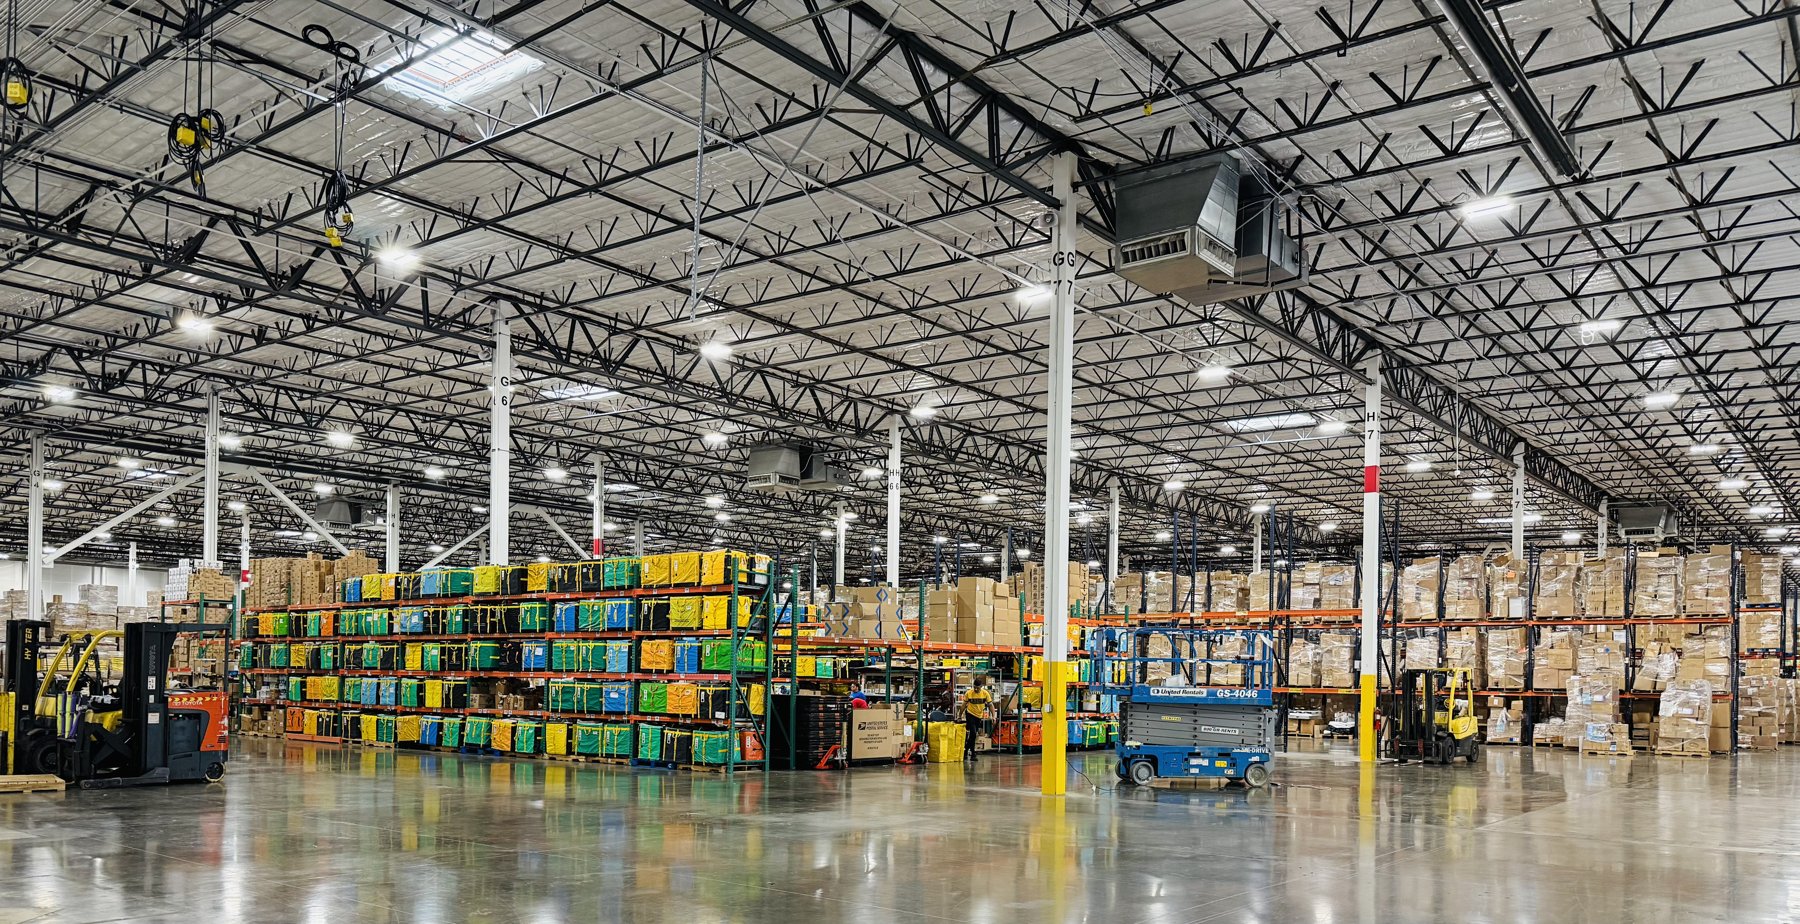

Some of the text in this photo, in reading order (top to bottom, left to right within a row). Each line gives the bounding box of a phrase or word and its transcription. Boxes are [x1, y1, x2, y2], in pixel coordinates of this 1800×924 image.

[1052, 251, 1065, 267] G
[1067, 251, 1075, 267] G
[1053, 279, 1063, 296] 7
[1067, 279, 1073, 296] 7
[500, 376, 509, 387] G
[501, 395, 508, 406] 6
[1367, 411, 1375, 422] H
[1367, 429, 1375, 440] 7
[24, 628, 33, 660] HYTER
[1160, 688, 1205, 696] United Rentals
[1216, 689, 1259, 698] GS-4046
